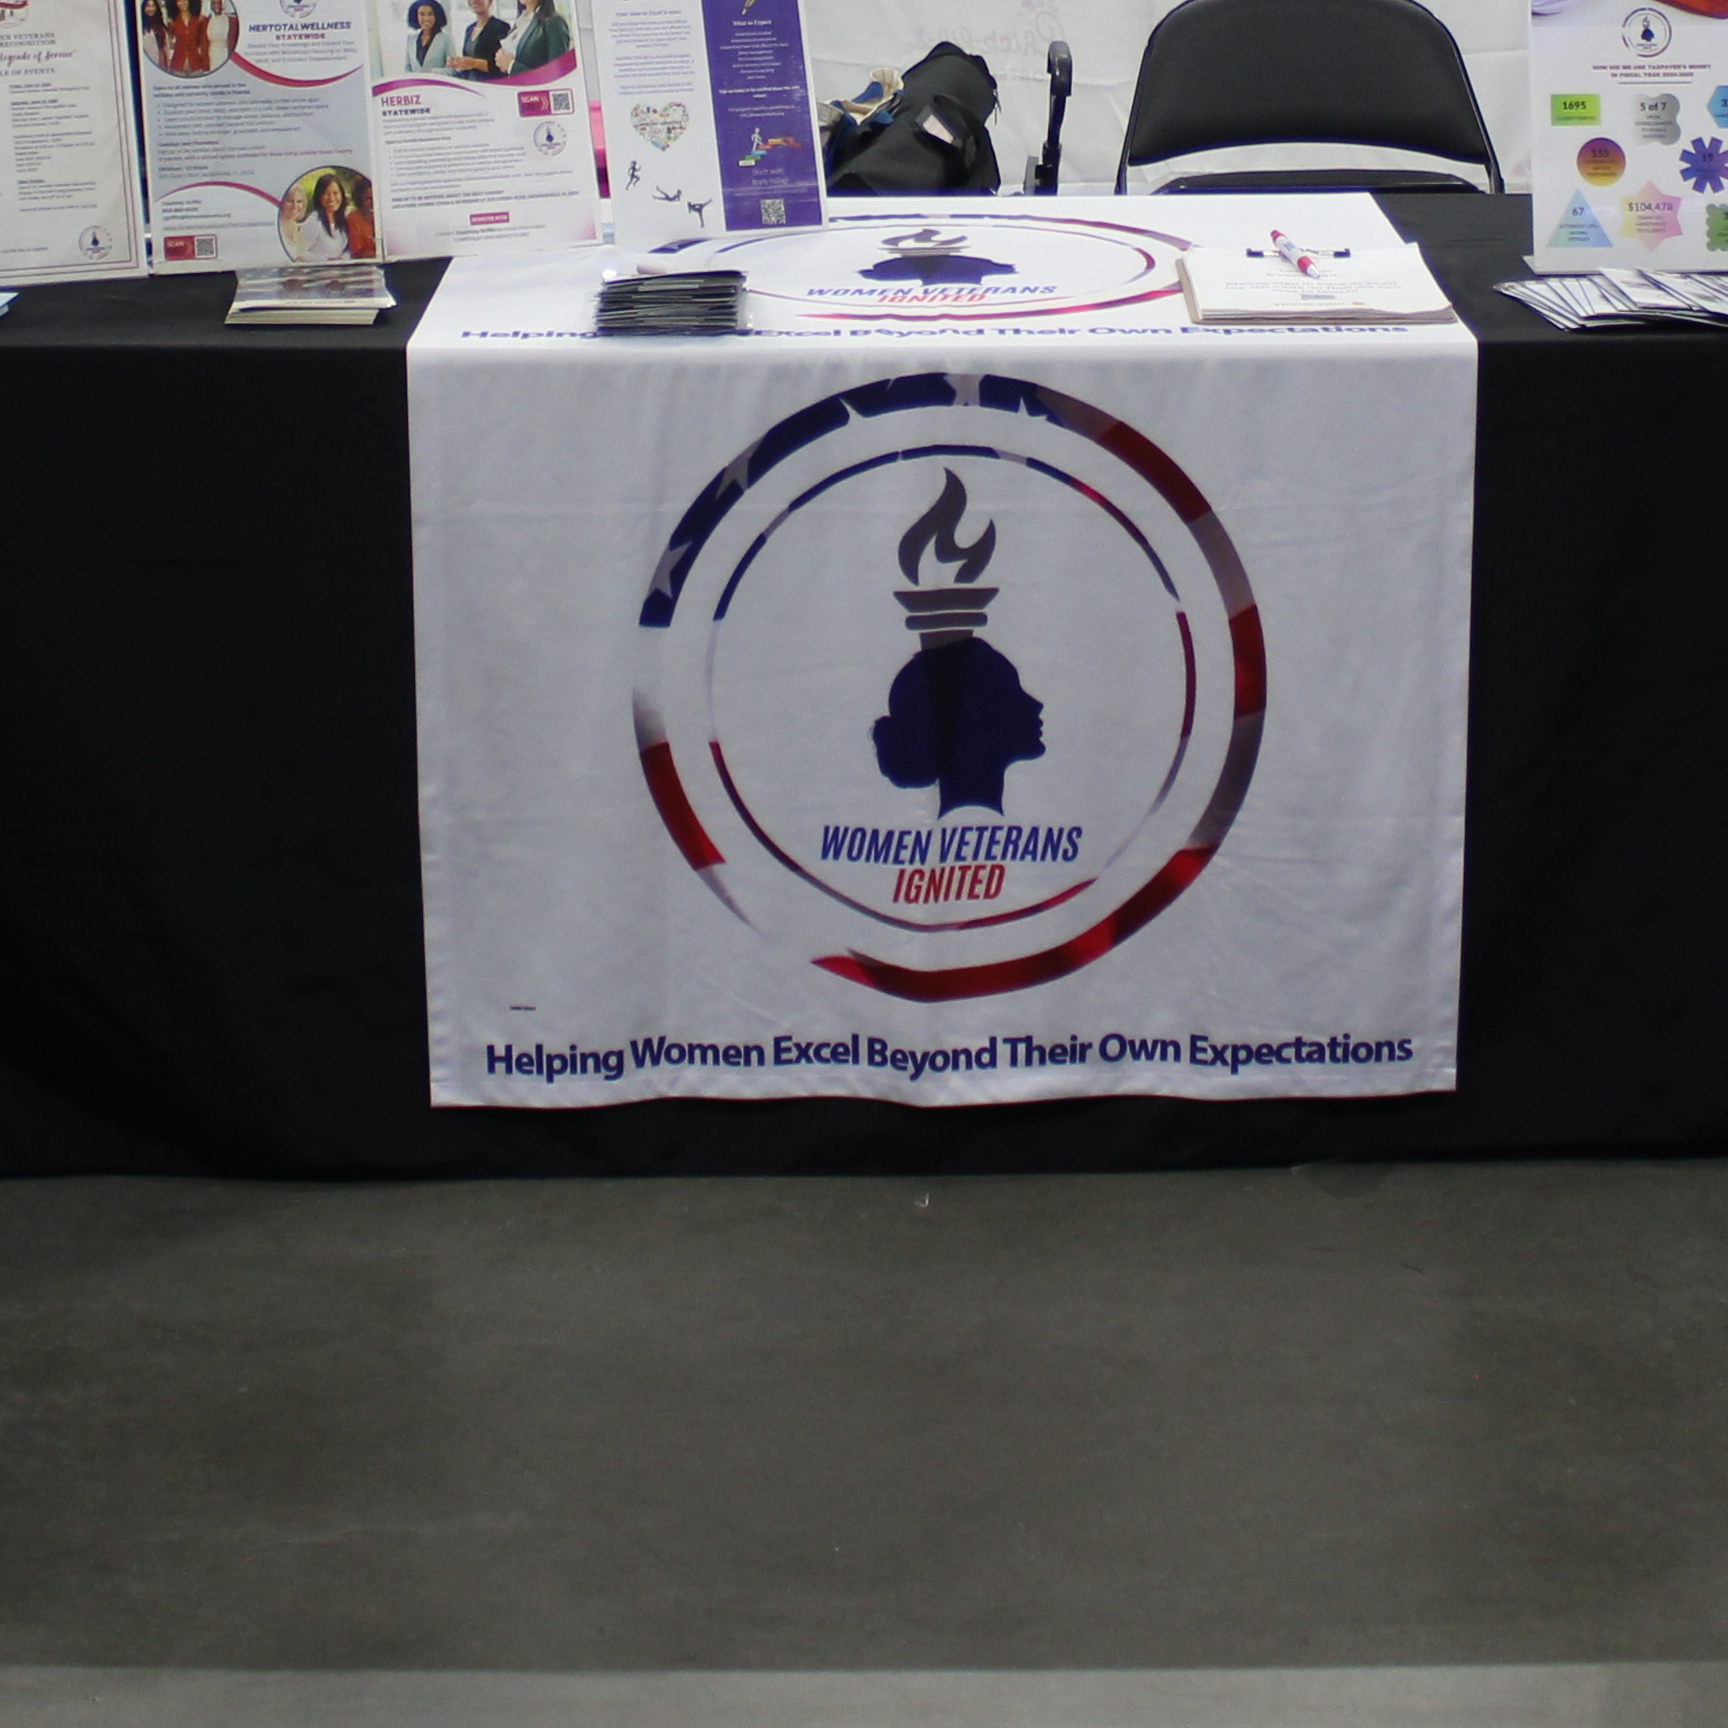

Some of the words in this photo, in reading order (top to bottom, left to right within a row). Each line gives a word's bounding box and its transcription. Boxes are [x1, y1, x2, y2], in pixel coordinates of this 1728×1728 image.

[248, 21, 352, 34] HERTOTALWELLNESS
[381, 95, 422, 107] HERBIZ
[1562, 100, 1587, 111] 1695
[1640, 102, 1647, 111] 5
[1648, 101, 1660, 111] of
[1660, 101, 1667, 111] 7
[381, 108, 432, 117] STATEWIDE
[1572, 206, 1584, 217] 67
[806, 287, 915, 297] WOMEN
[920, 286, 1059, 296] VETERANS
[875, 293, 987, 304] IGNITED
[990, 327, 1082, 337] Their
[1087, 325, 1173, 336] Own
[1178, 325, 1409, 336] Expectations
[821, 825, 932, 866] WOMEN
[939, 824, 1083, 864] VETERANS
[892, 863, 1005, 905] IGNITED
[485, 1044, 625, 1083] Helping
[629, 1035, 765, 1069] Women
[772, 1033, 860, 1066] Excel
[867, 1036, 997, 1082] Beyond
[1003, 1034, 1093, 1067] Their
[1098, 1033, 1182, 1063] Own
[1189, 1033, 1414, 1075] Expectations
